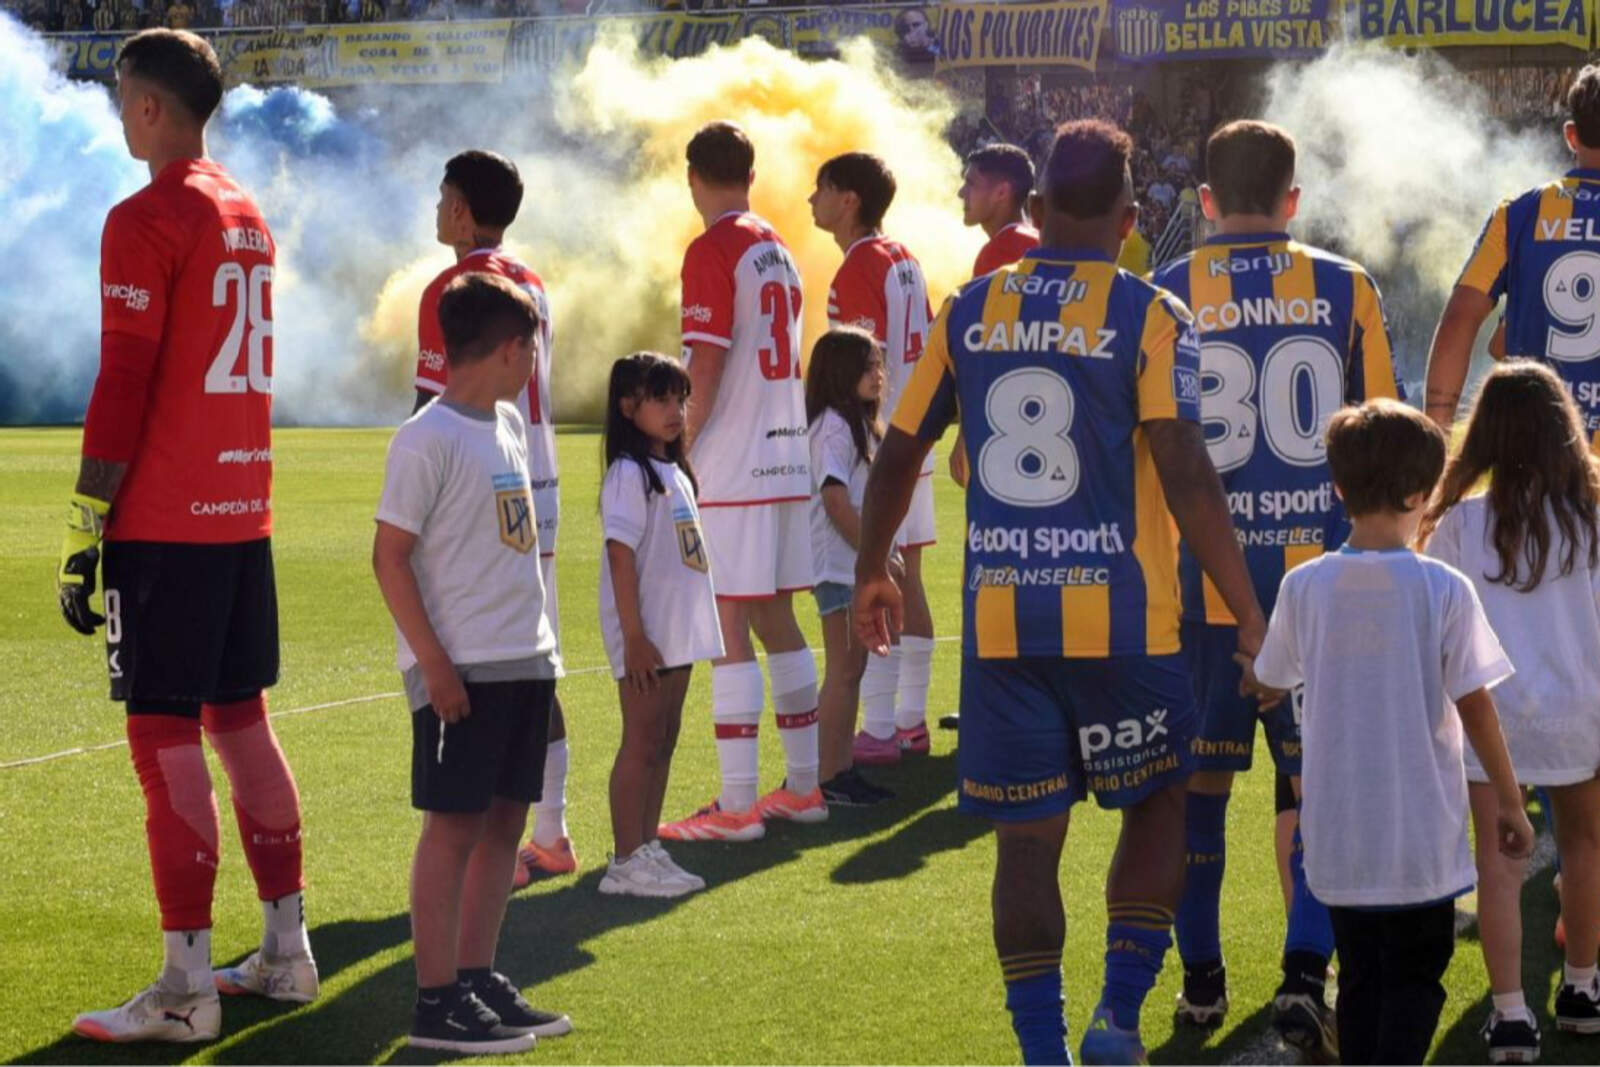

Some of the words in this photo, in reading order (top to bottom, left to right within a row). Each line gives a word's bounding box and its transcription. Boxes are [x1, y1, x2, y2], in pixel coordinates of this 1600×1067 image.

[1185, 0, 1218, 18] LOS
[1227, 0, 1282, 17] PIBES
[1360, 0, 1586, 37] BARLUCEA
[939, 8, 975, 61] LOS
[979, 6, 1100, 61] POLVORINES
[1165, 21, 1246, 52] BELLA
[1250, 20, 1324, 48] VISTA
[1541, 218, 1600, 241] VEL
[1209, 254, 1292, 277] kanji
[1003, 273, 1088, 304] kanji
[1197, 297, 1332, 332] CONNOR
[1542, 251, 1600, 363] 9
[204, 262, 274, 394] 28
[963, 320, 1117, 359] CAMPAZ
[1199, 335, 1345, 473] 30
[978, 366, 1080, 508] 8
[1233, 528, 1324, 546] ANSELEC
[983, 567, 1110, 586] TRANSELEC
[1079, 709, 1168, 760] pax
[1083, 744, 1168, 771] assistance
[1123, 754, 1179, 788] CENTRAL
